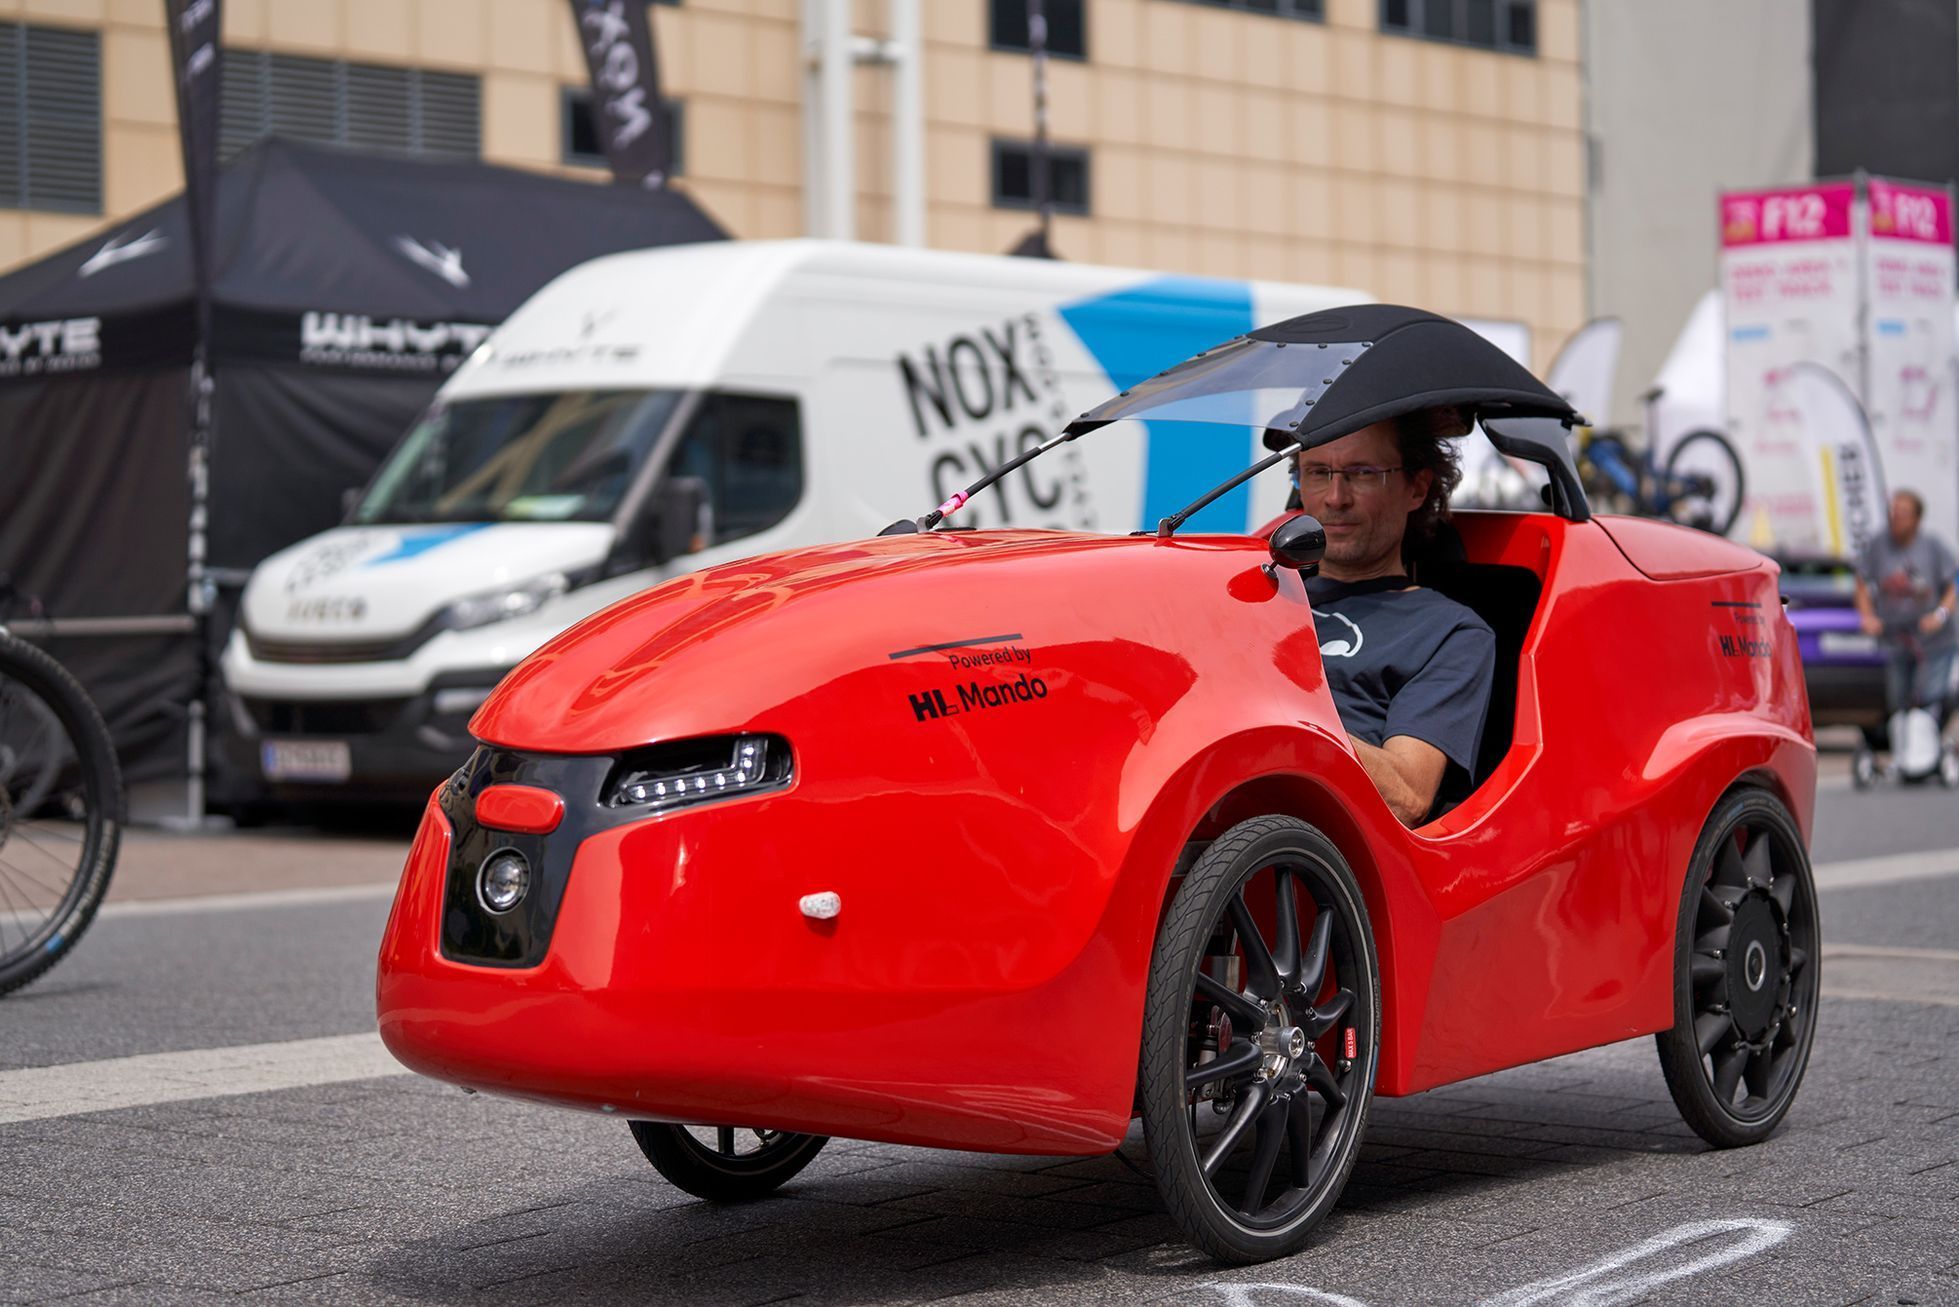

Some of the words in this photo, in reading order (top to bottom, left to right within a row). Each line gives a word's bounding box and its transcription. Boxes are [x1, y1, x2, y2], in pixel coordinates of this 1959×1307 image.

[896, 320, 1038, 438] NOX
[949, 645, 1013, 670] Powered
[1012, 646, 1031, 664] by
[908, 689, 960, 722] HL
[955, 673, 1048, 712] Mando
